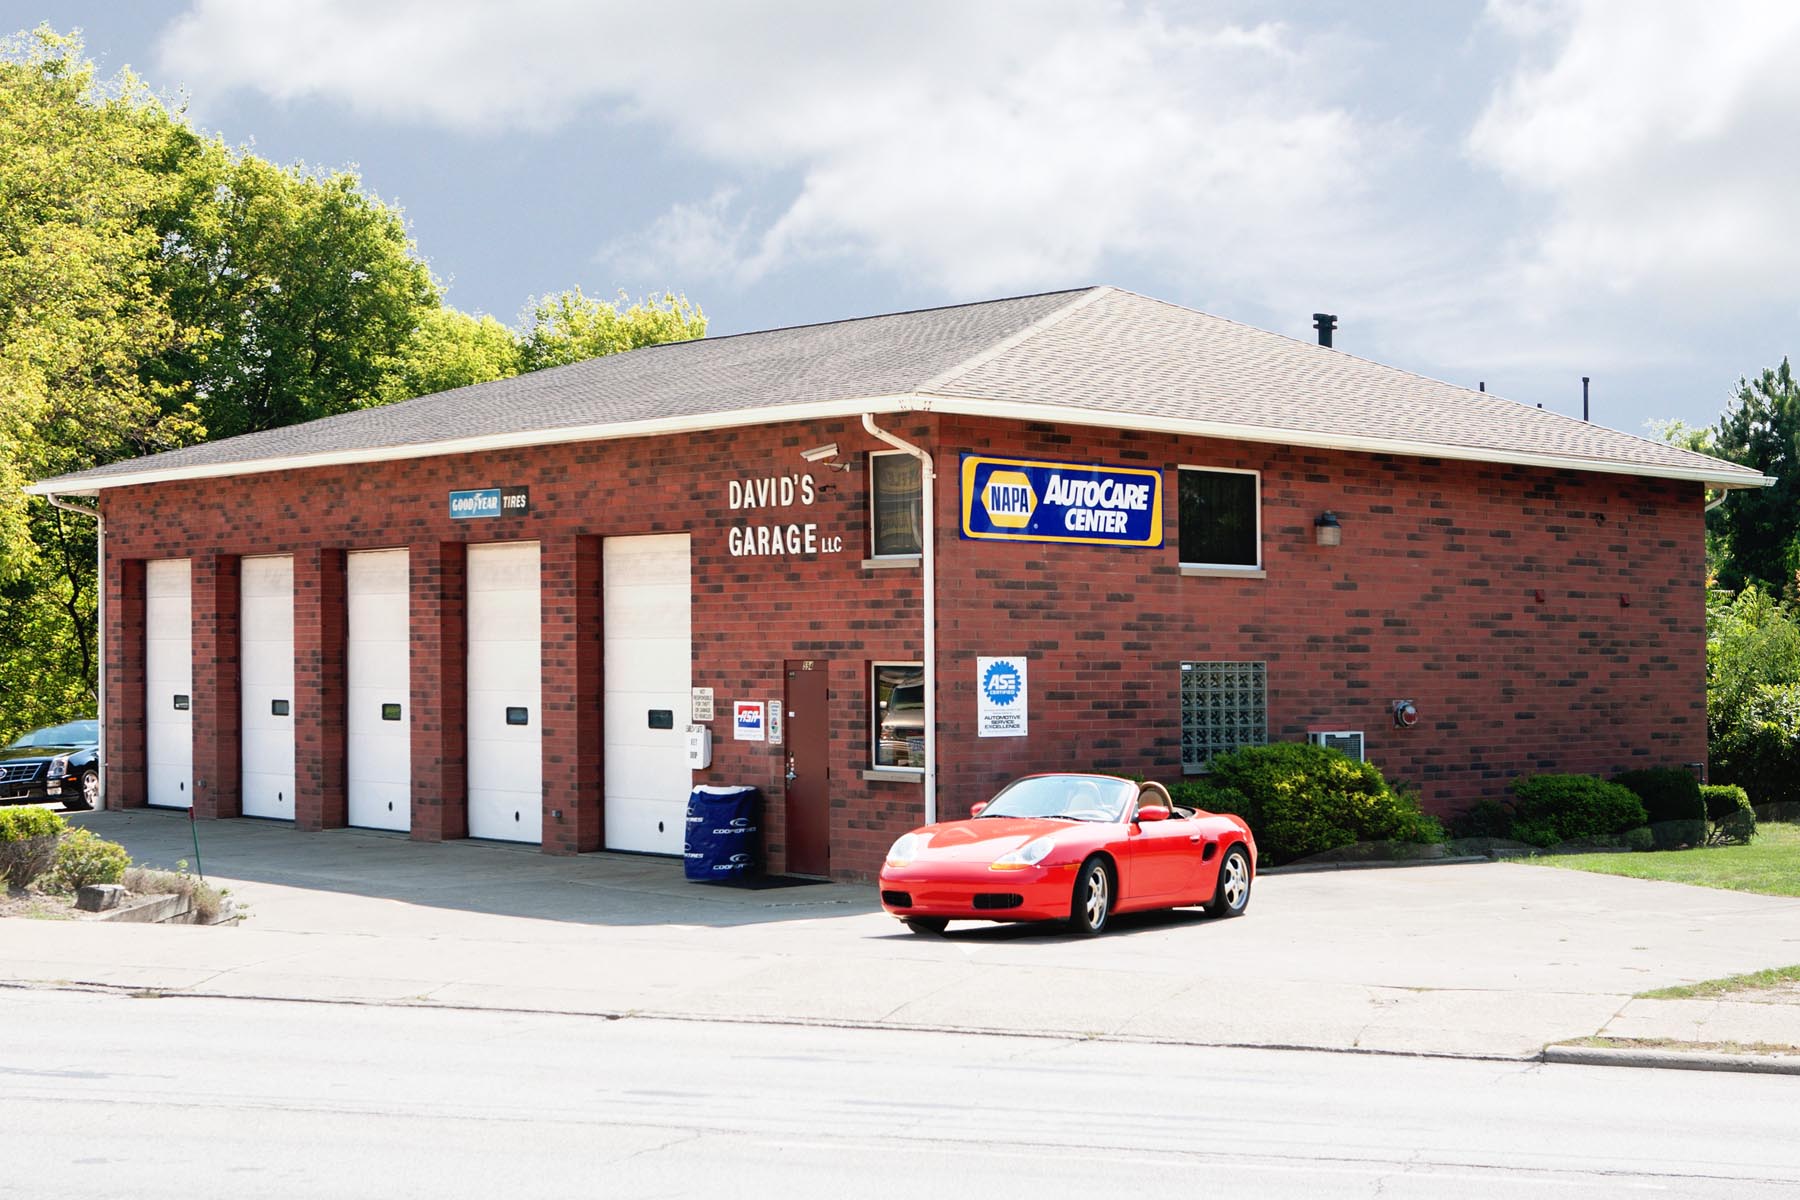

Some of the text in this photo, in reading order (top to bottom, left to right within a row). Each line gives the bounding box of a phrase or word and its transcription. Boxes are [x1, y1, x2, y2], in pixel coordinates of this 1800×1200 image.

[503, 494, 527, 508] TIRES
[729, 474, 814, 509] DAVID'S
[991, 486, 1029, 513] NAPA
[1064, 508, 1128, 534] CENTER
[729, 524, 842, 557] GARAGE LLC
[988, 674, 1016, 690] ASE
